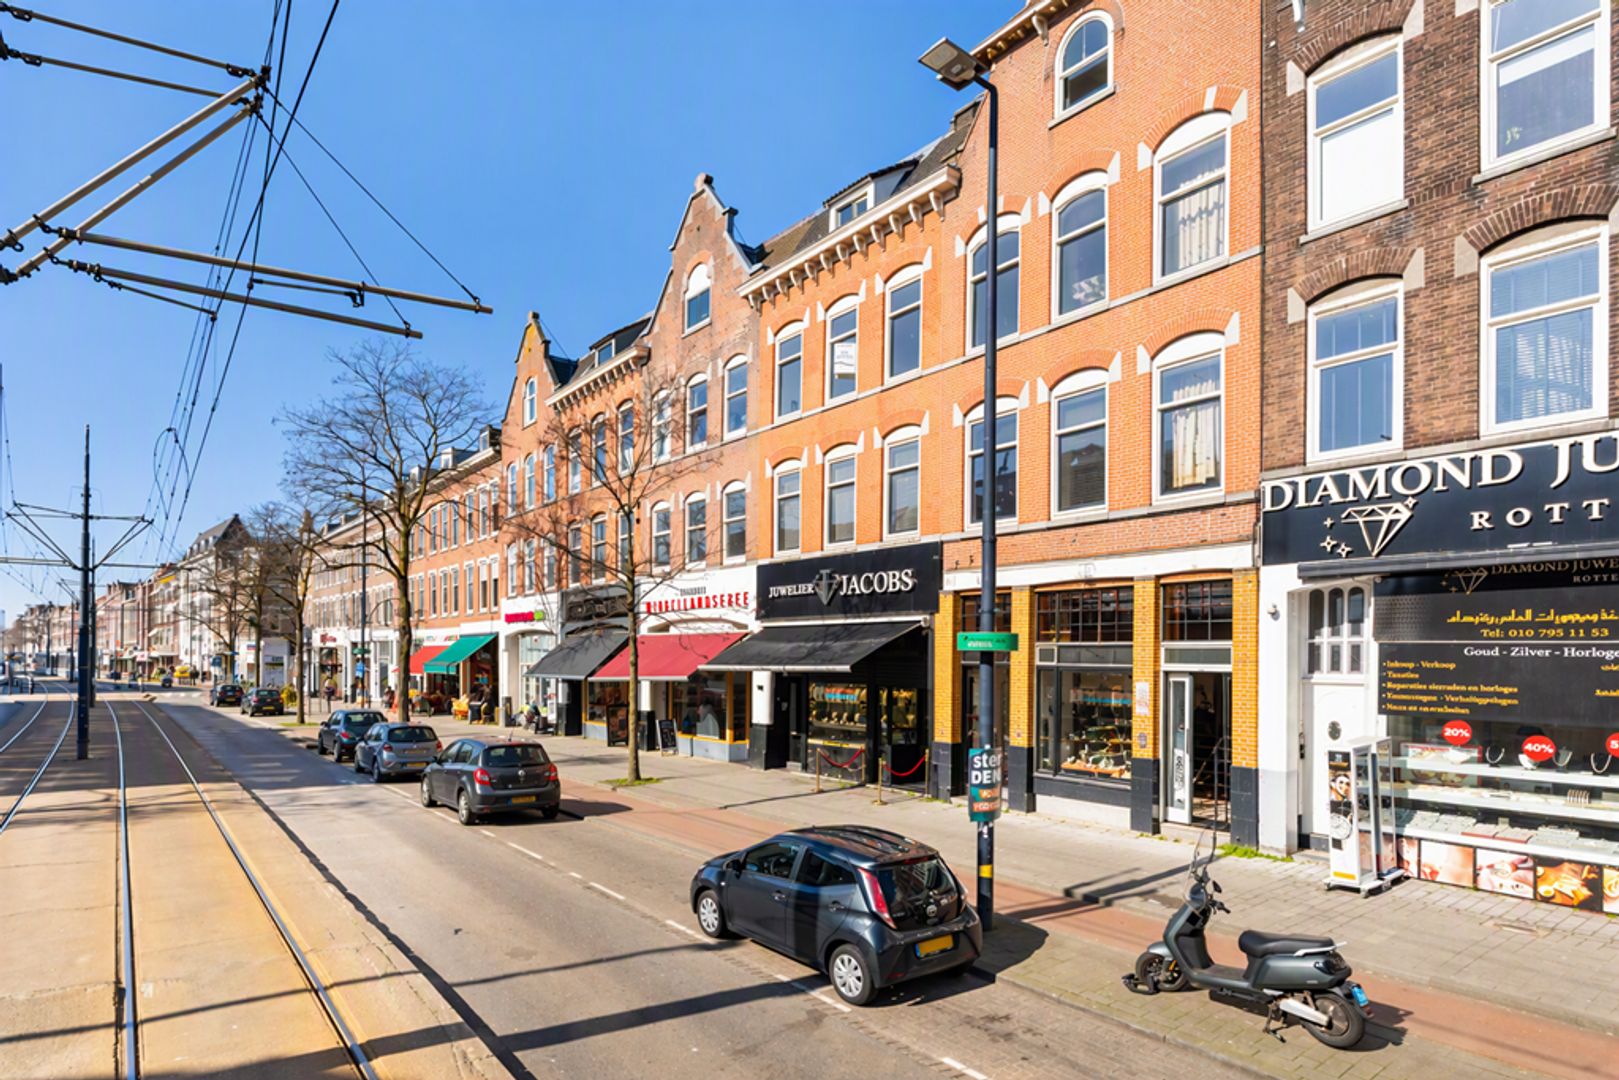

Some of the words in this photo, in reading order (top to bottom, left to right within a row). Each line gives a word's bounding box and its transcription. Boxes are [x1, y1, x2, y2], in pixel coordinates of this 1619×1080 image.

[1261, 449, 1524, 513] DIAMOND
[1550, 436, 1619, 488] JU
[1470, 498, 1610, 530] ROTT
[1491, 560, 1570, 575] DIAMOND
[1572, 557, 1619, 573] JUWE
[768, 583, 815, 598] JUWELIER
[840, 568, 914, 596] JACOBS
[1480, 628, 1504, 638] Tel:
[1508, 628, 1535, 637] 010
[1538, 628, 1564, 637] 795
[1569, 628, 1585, 637] 11
[1591, 627, 1610, 637] 53
[1463, 647, 1500, 657] Goud
[1510, 647, 1552, 657] Zilver
[1443, 727, 1470, 737] 20%
[1523, 742, 1554, 753] 40%
